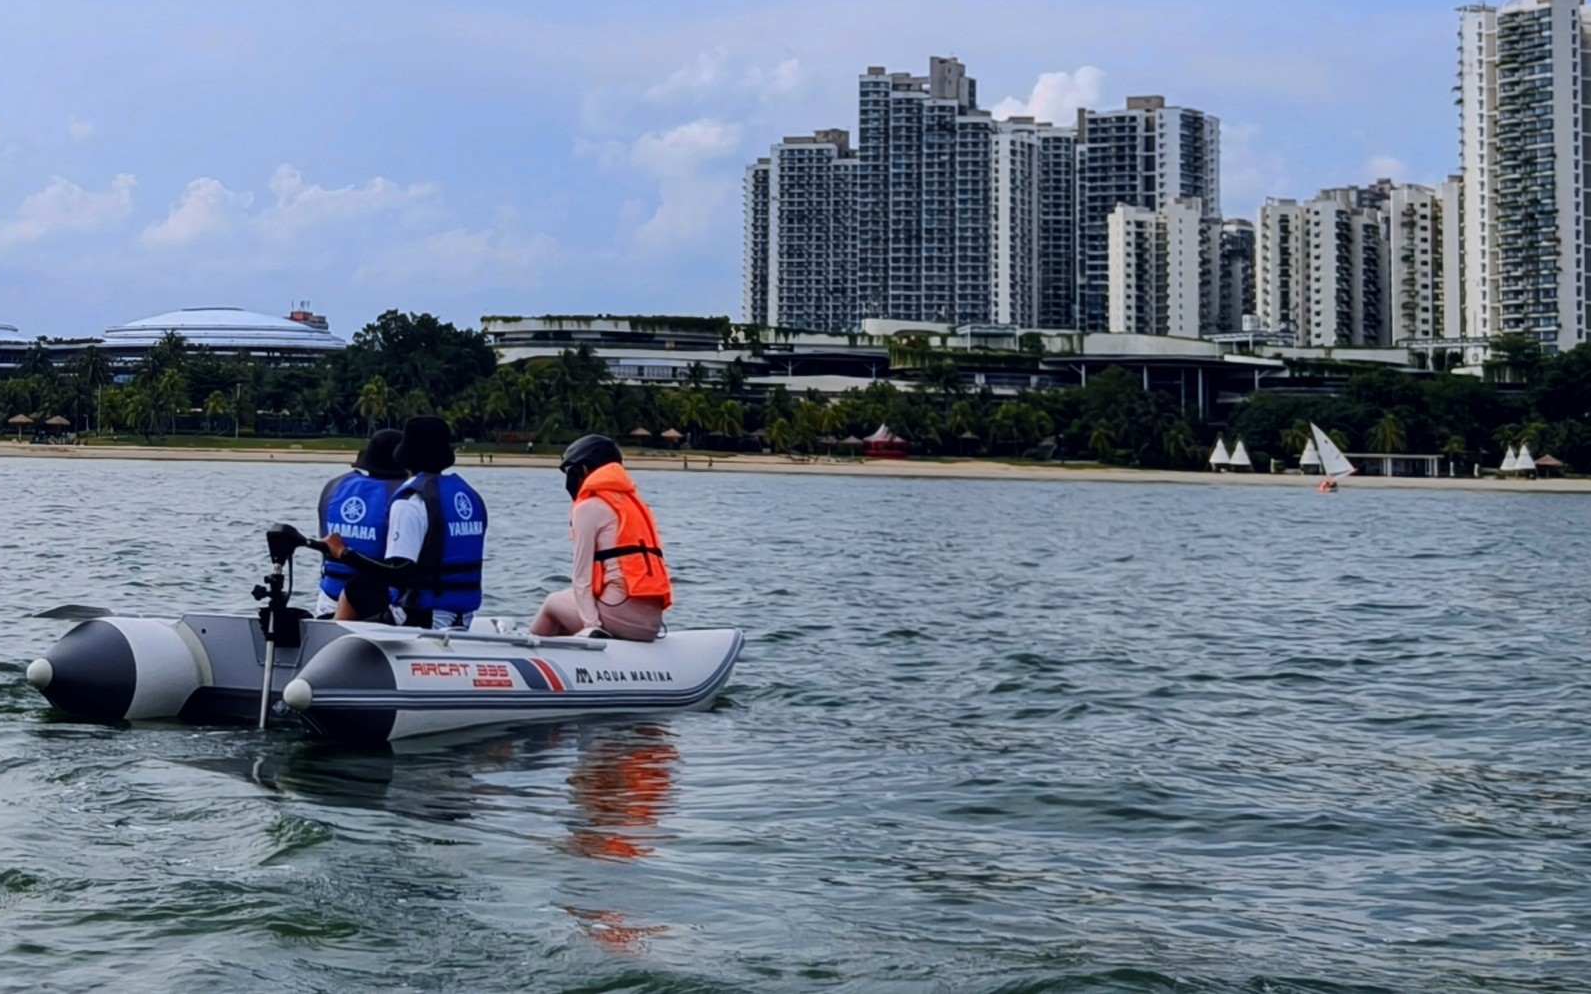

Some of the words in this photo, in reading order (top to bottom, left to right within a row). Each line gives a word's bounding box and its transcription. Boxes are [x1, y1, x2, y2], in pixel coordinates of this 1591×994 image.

[327, 521, 377, 541] YAMAHA
[448, 521, 483, 537] YAMAHA
[411, 663, 469, 676] AIRCAT
[476, 664, 509, 677] 335
[596, 670, 627, 682] AQUA
[630, 671, 674, 682] MARINA
